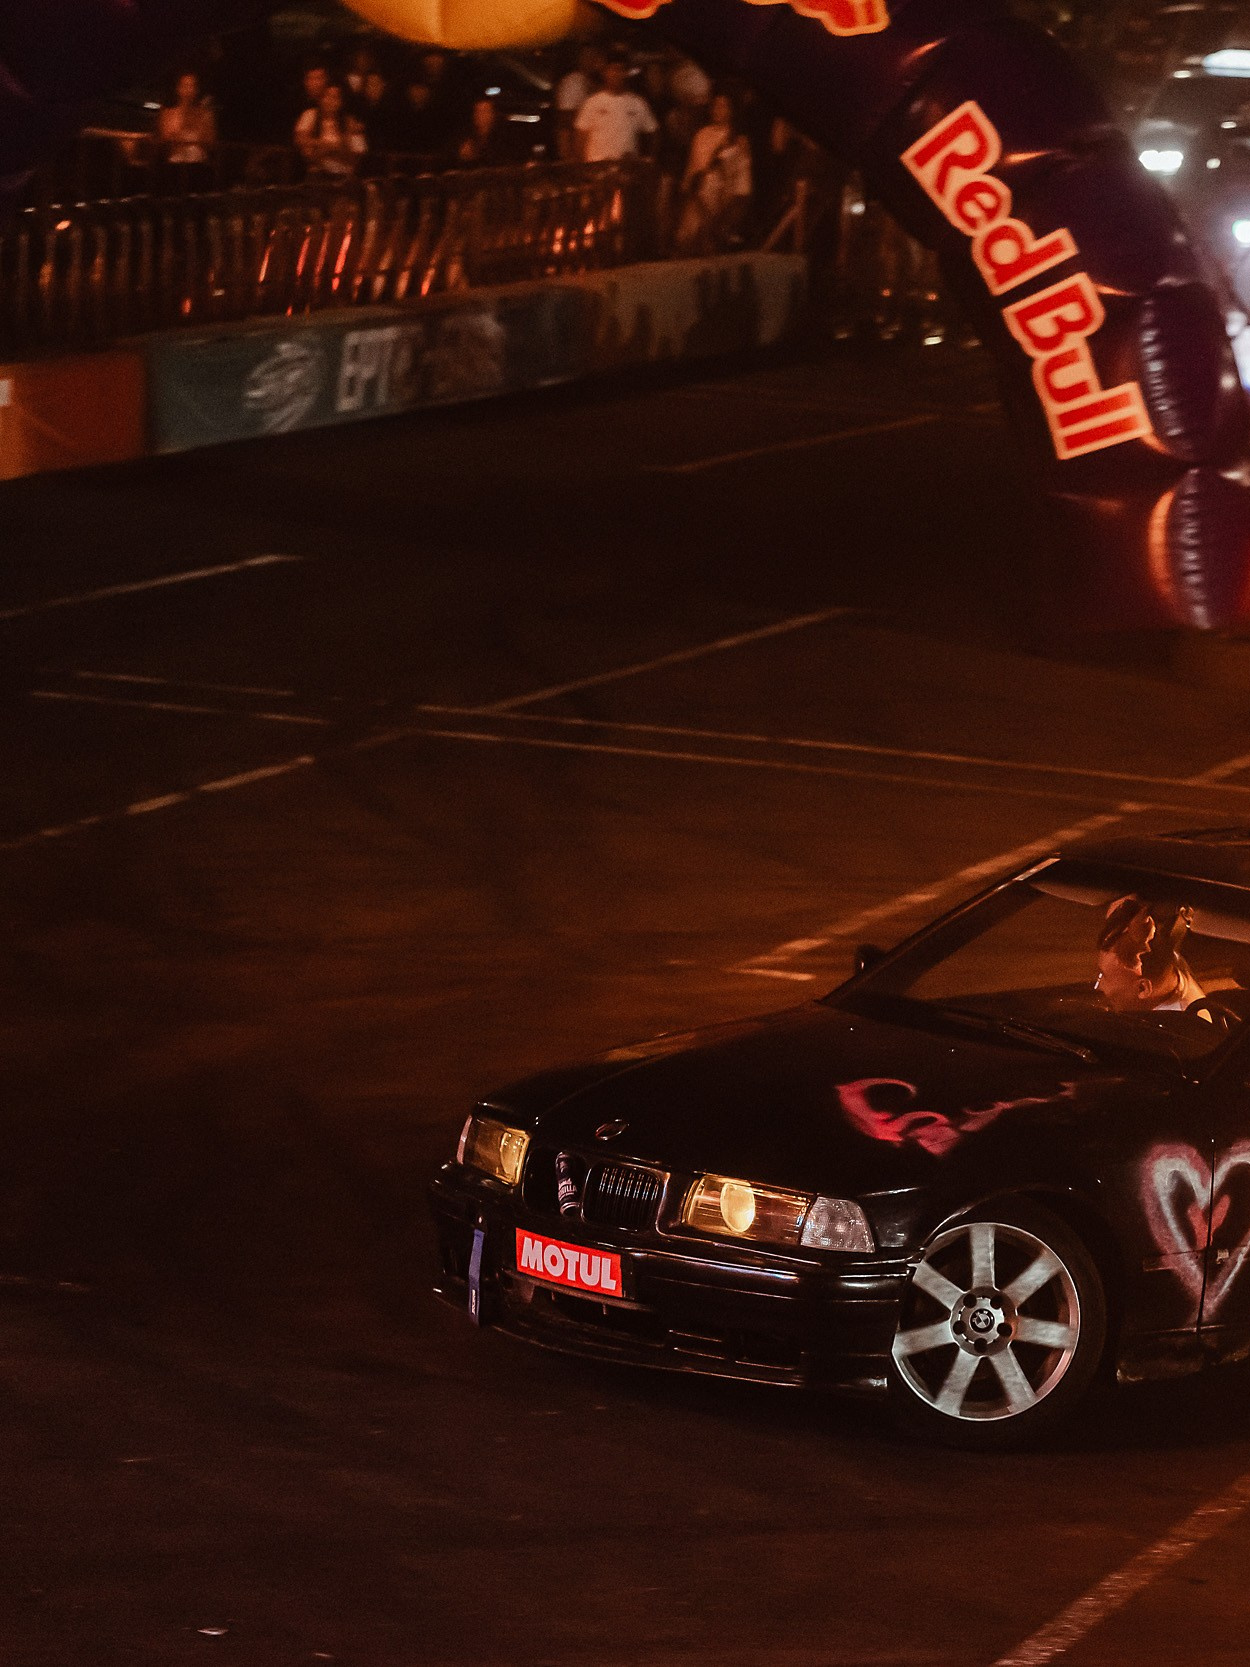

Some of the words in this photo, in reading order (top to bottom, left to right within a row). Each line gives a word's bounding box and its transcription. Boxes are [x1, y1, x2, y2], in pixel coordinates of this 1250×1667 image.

[901, 101, 1079, 296] Red
[1002, 272, 1152, 460] Bull
[521, 1236, 617, 1291] MOTUL
